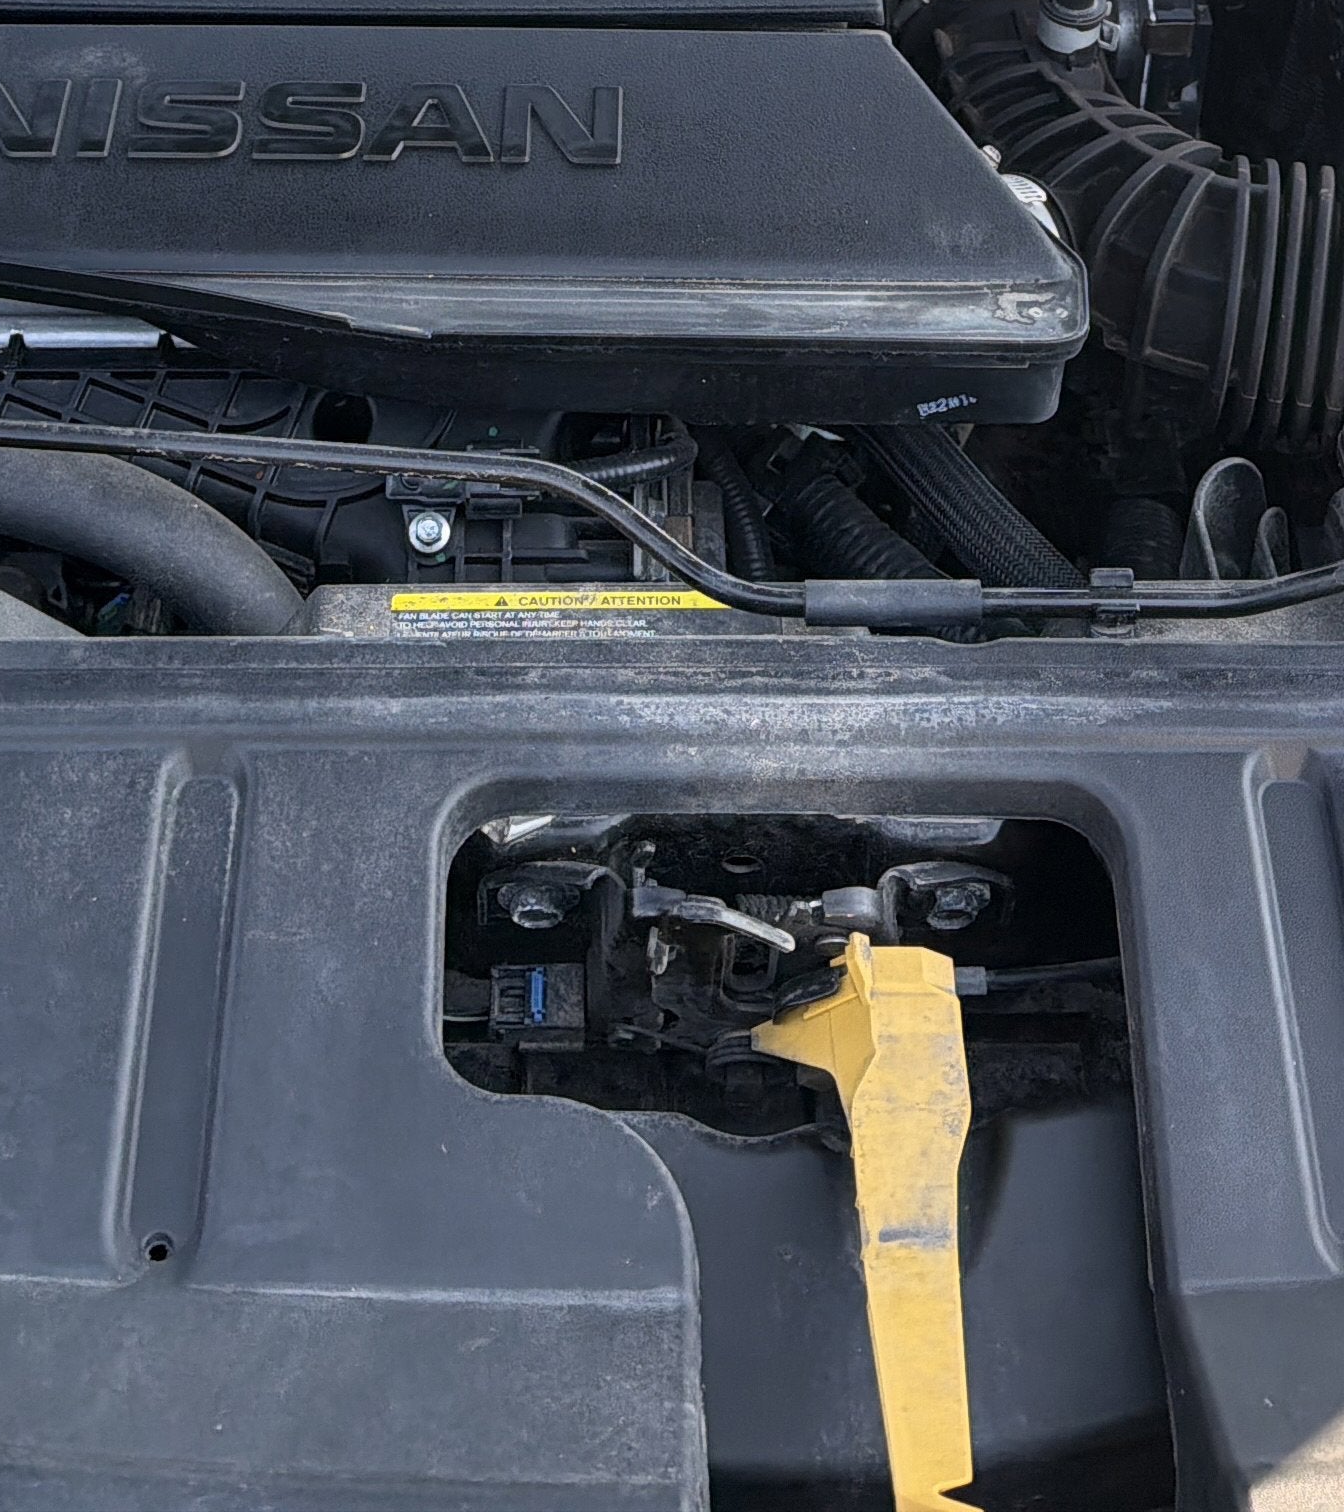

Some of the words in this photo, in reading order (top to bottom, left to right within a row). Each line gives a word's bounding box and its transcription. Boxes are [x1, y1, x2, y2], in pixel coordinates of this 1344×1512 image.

[518, 595, 584, 606] CAUTION
[600, 595, 681, 606] ATTENTION
[419, 611, 450, 620] BLADE
[451, 611, 471, 620] CAN
[475, 611, 502, 620] START
[504, 611, 516, 619] AT
[518, 611, 538, 619] ANY
[439, 621, 468, 629] AVOID
[469, 621, 520, 629] PERSONAL
[554, 620, 579, 628] KEEP
